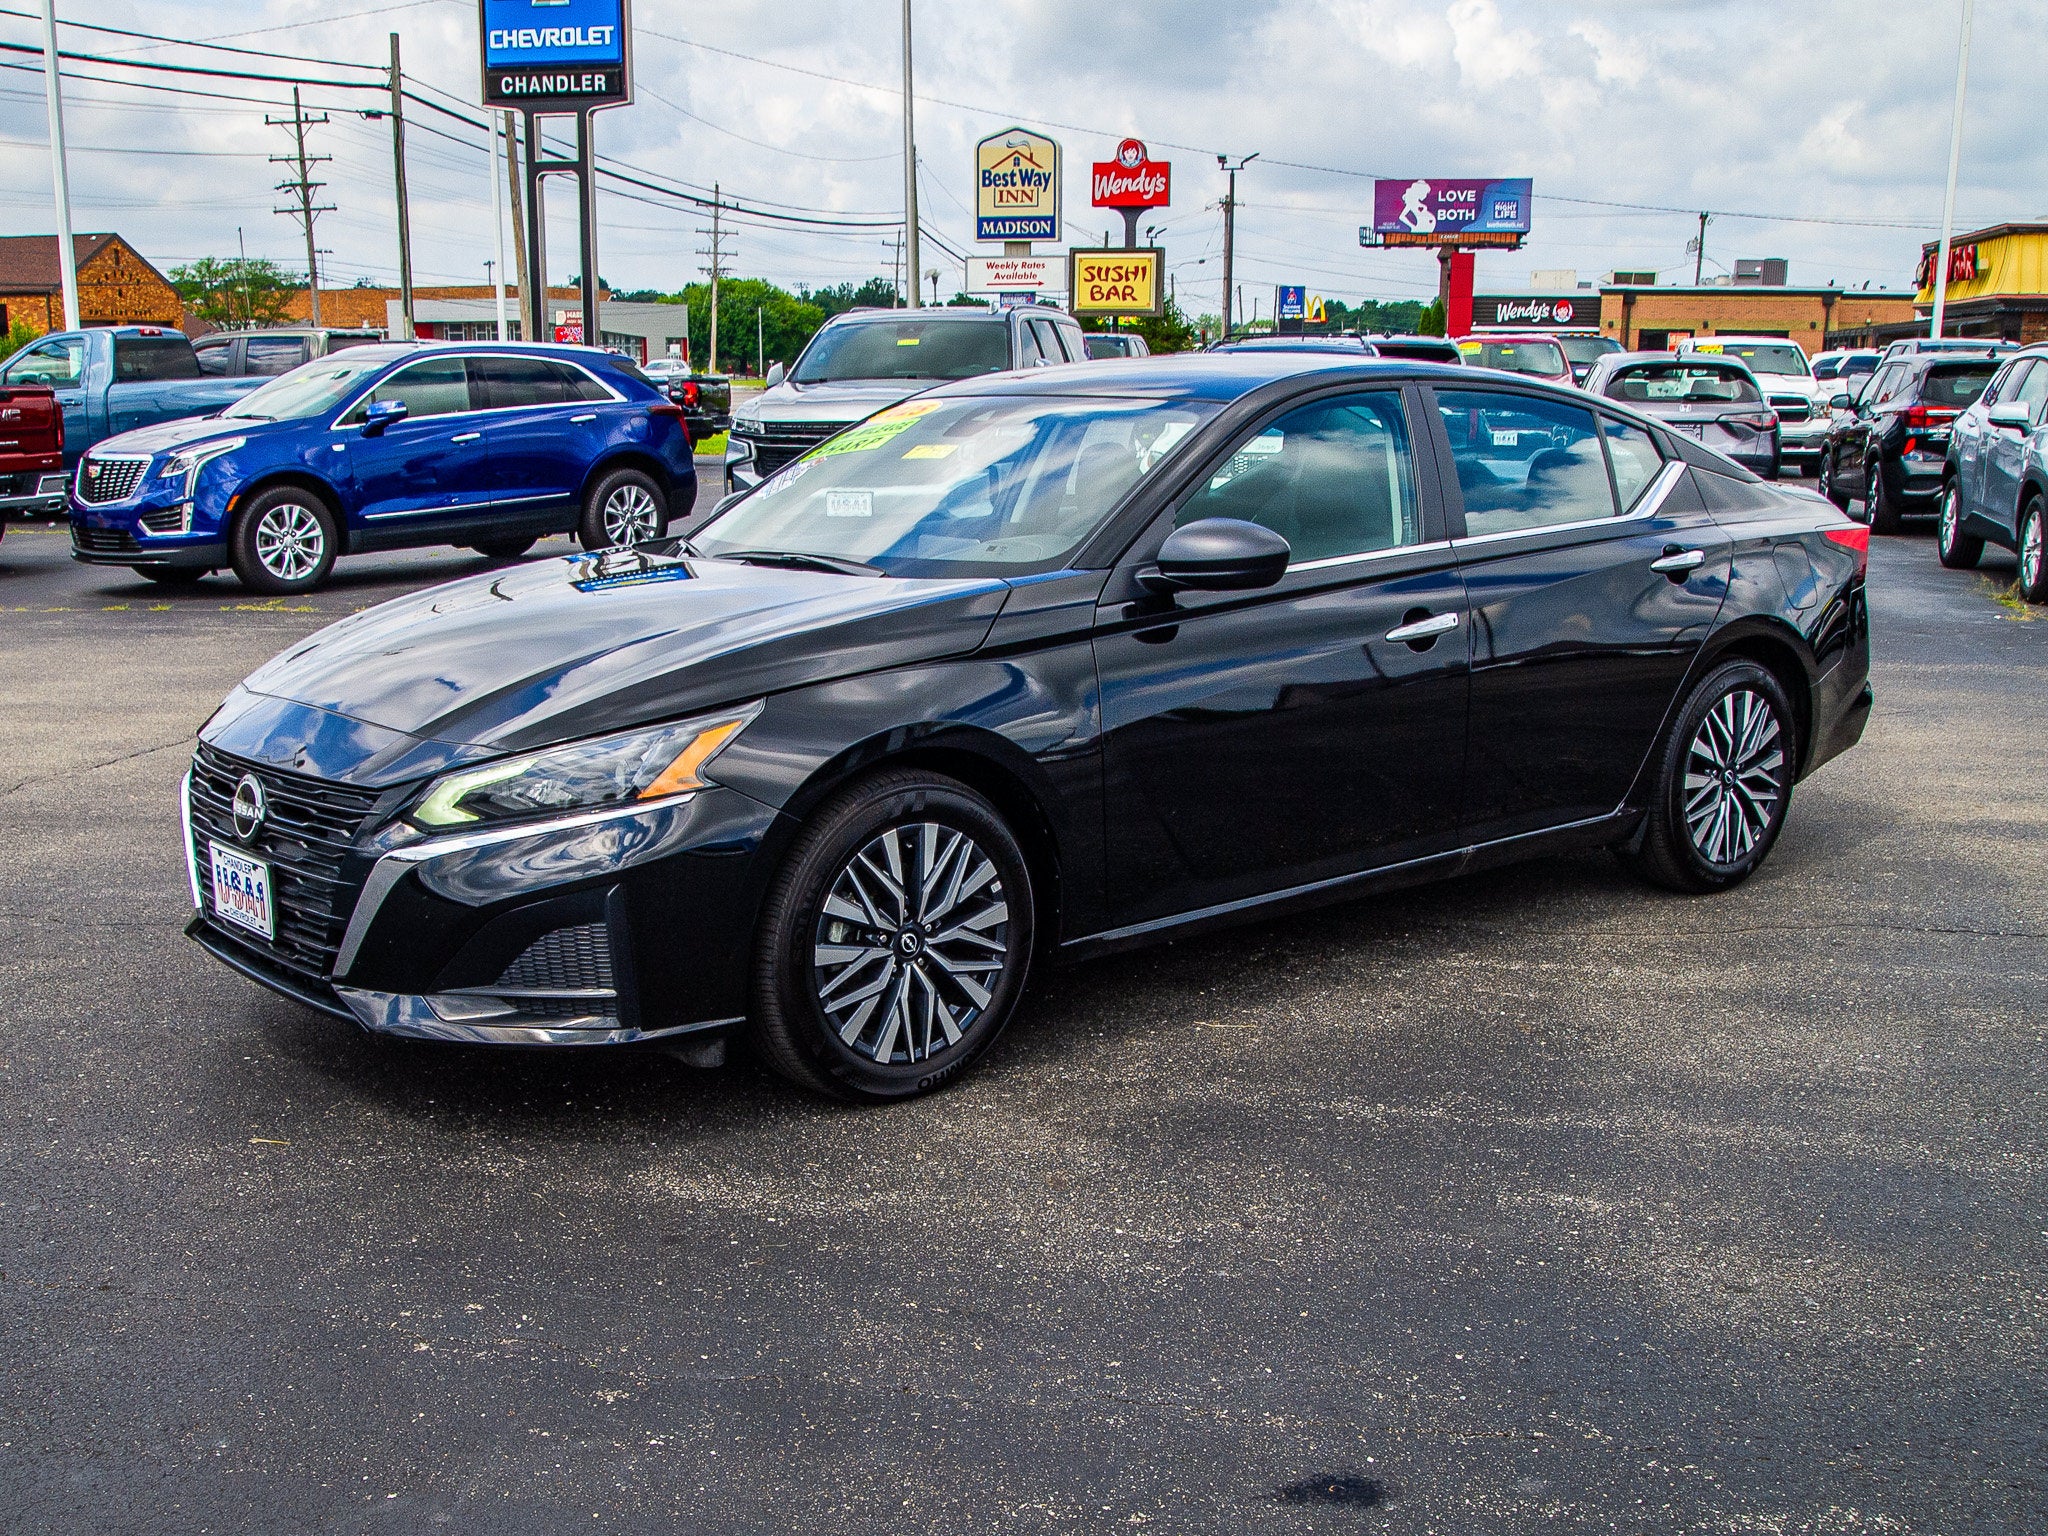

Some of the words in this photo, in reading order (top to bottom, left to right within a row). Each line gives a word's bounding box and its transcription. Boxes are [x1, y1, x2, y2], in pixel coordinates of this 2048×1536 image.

[490, 26, 614, 49] CHEVROLET
[501, 74, 606, 94] CHANDLER
[981, 168, 1016, 188] Best
[1018, 169, 1052, 193] Way
[1093, 168, 1166, 200] Wendy's
[998, 190, 1034, 203] INN
[1438, 190, 1476, 202] LOVE
[1437, 209, 1475, 221] BOTH
[1494, 211, 1517, 219] LIFE
[981, 220, 1051, 235] MADISON
[986, 261, 1018, 271] Weekly
[1021, 261, 1046, 269] Rates
[1083, 265, 1147, 283] SUSHI
[994, 271, 1037, 280] Available
[1090, 285, 1138, 302] BAR
[1496, 299, 1550, 323] Wendy's
[223, 855, 252, 875] CHANDLER
[229, 907, 257, 926] CHEVROLET
